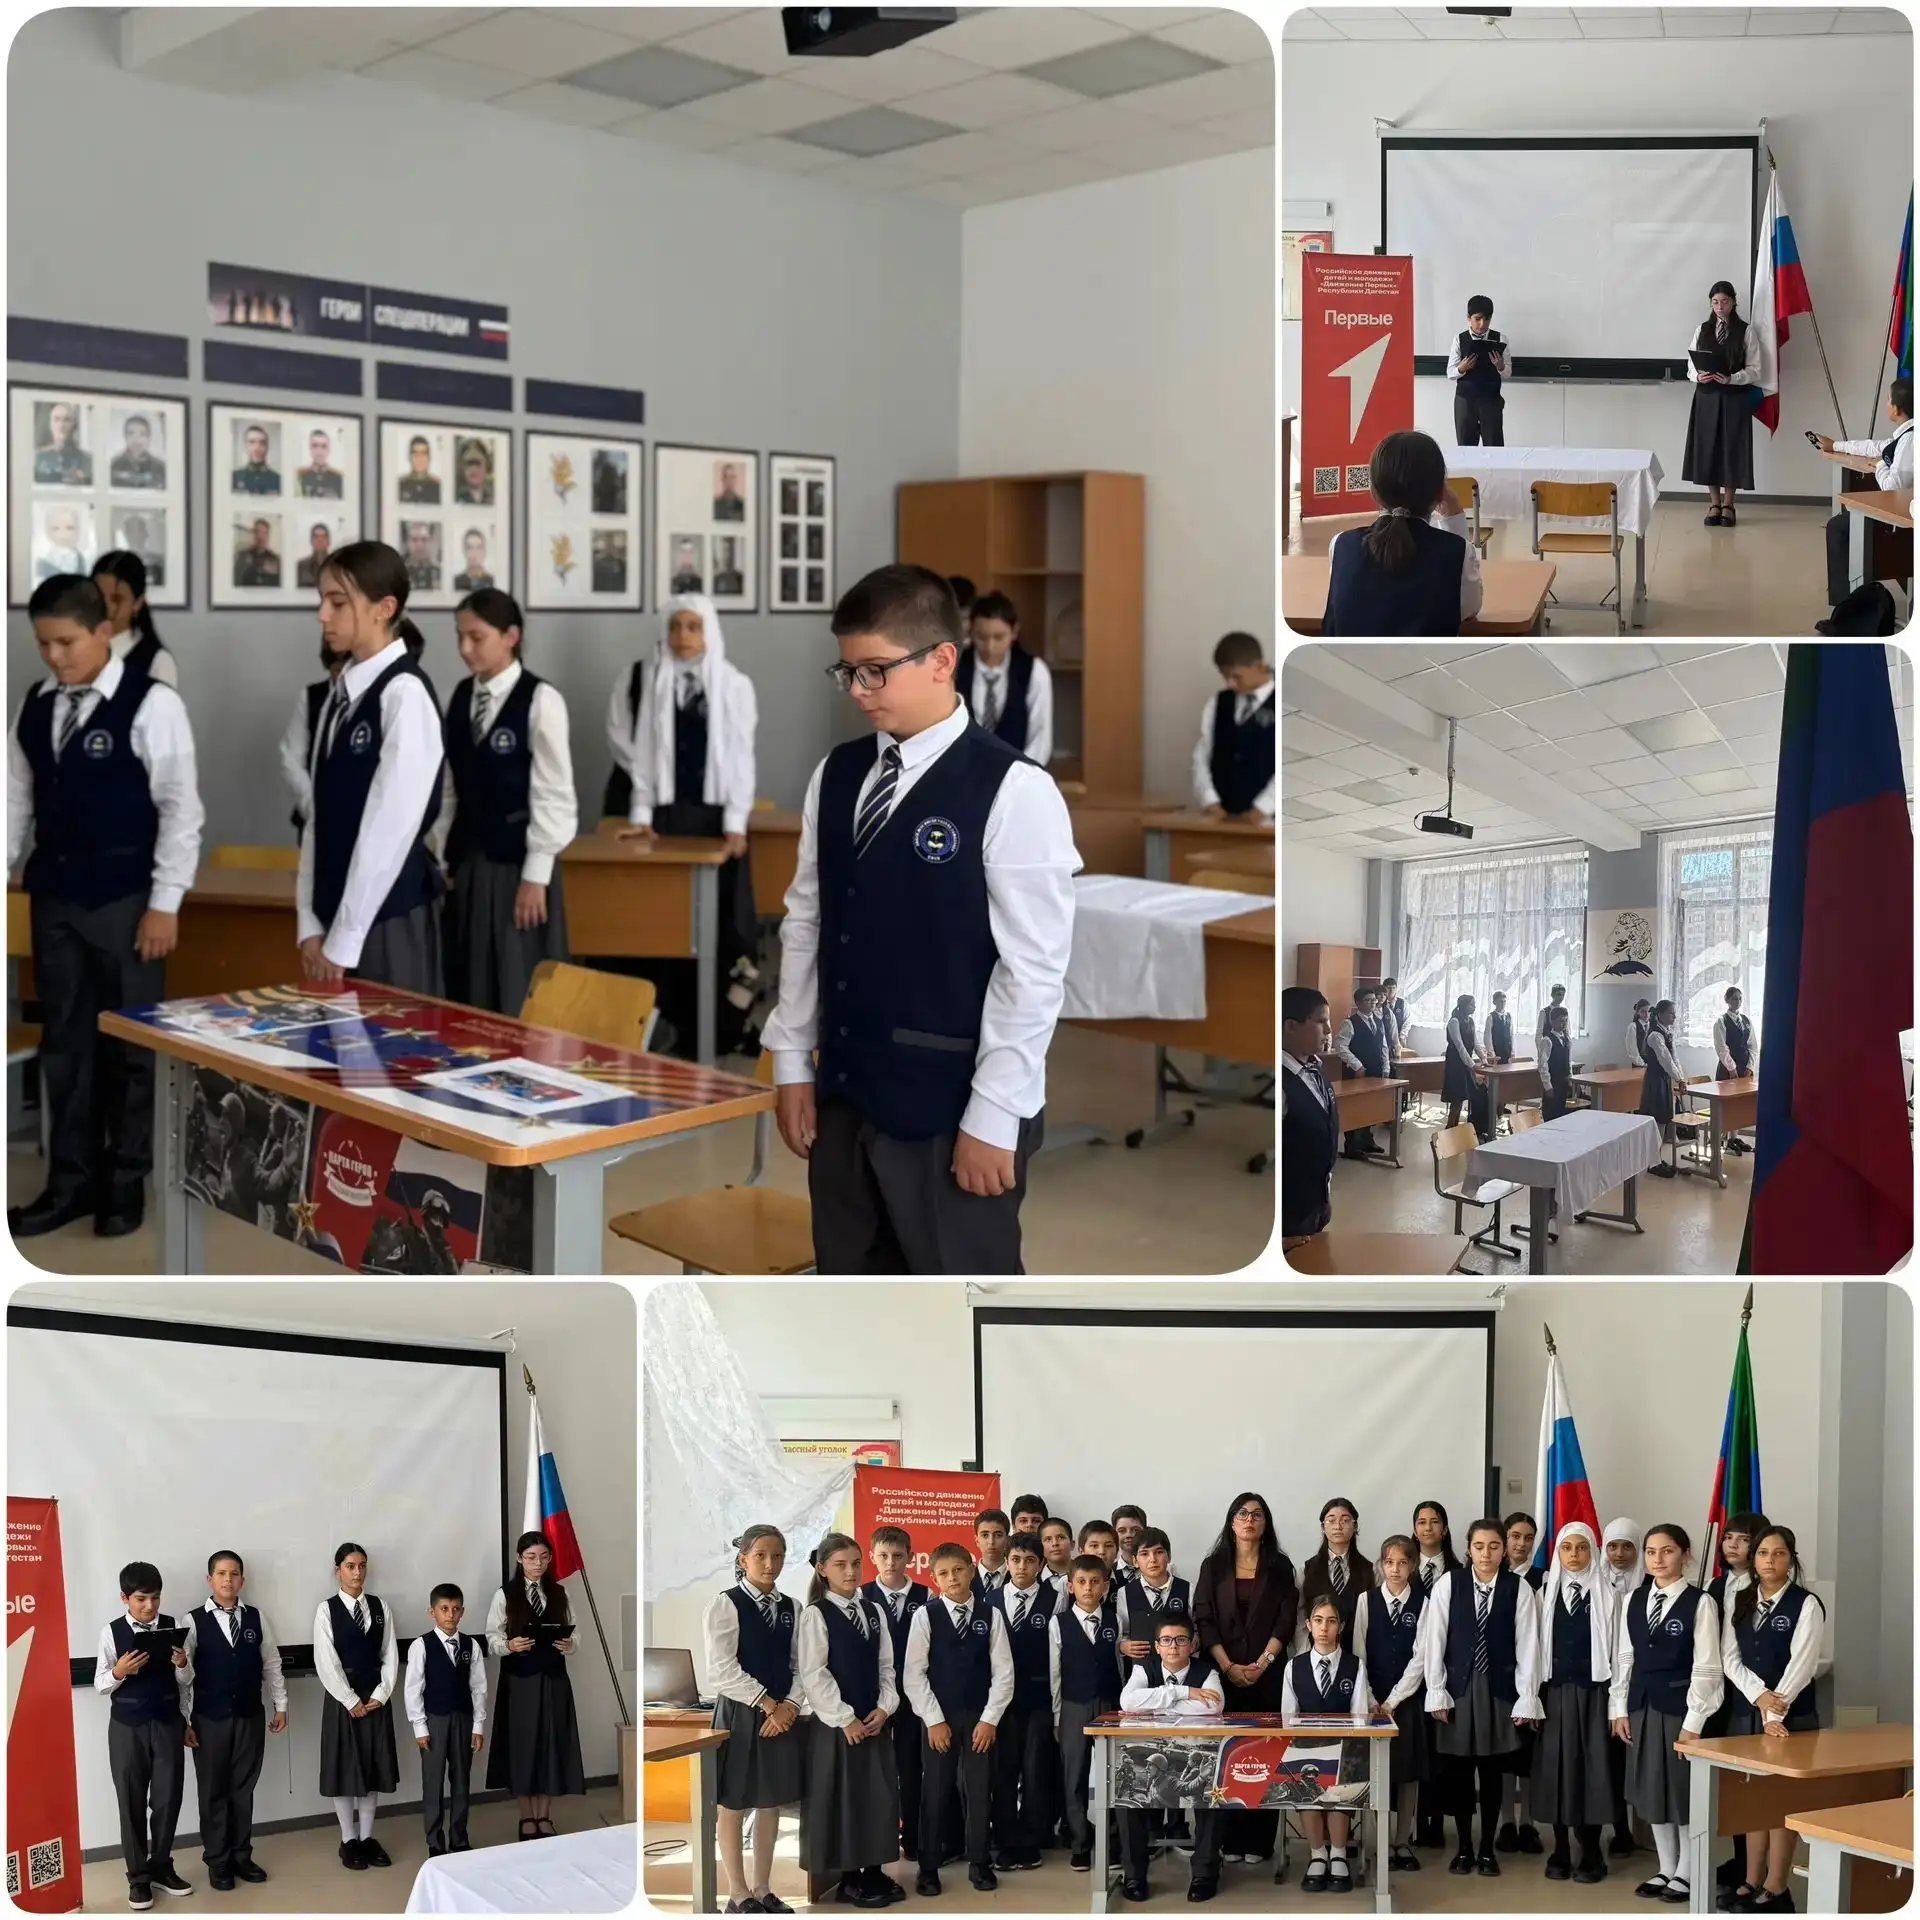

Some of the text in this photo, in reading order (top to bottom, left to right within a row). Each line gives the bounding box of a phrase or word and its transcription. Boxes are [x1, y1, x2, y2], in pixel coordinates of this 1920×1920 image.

[1315, 267, 1362, 275] Российское
[1317, 287, 1364, 295] Республики
[320, 297, 362, 322] ГЕРОИ
[1324, 309, 1393, 330] Первые
[818, 1446, 848, 1455] уголок
[871, 1486, 985, 1501] Российское движение
[883, 1498, 914, 1506] детей
[924, 1500, 976, 1509] молодежи
[875, 1514, 974, 1527] Республики Дагест
